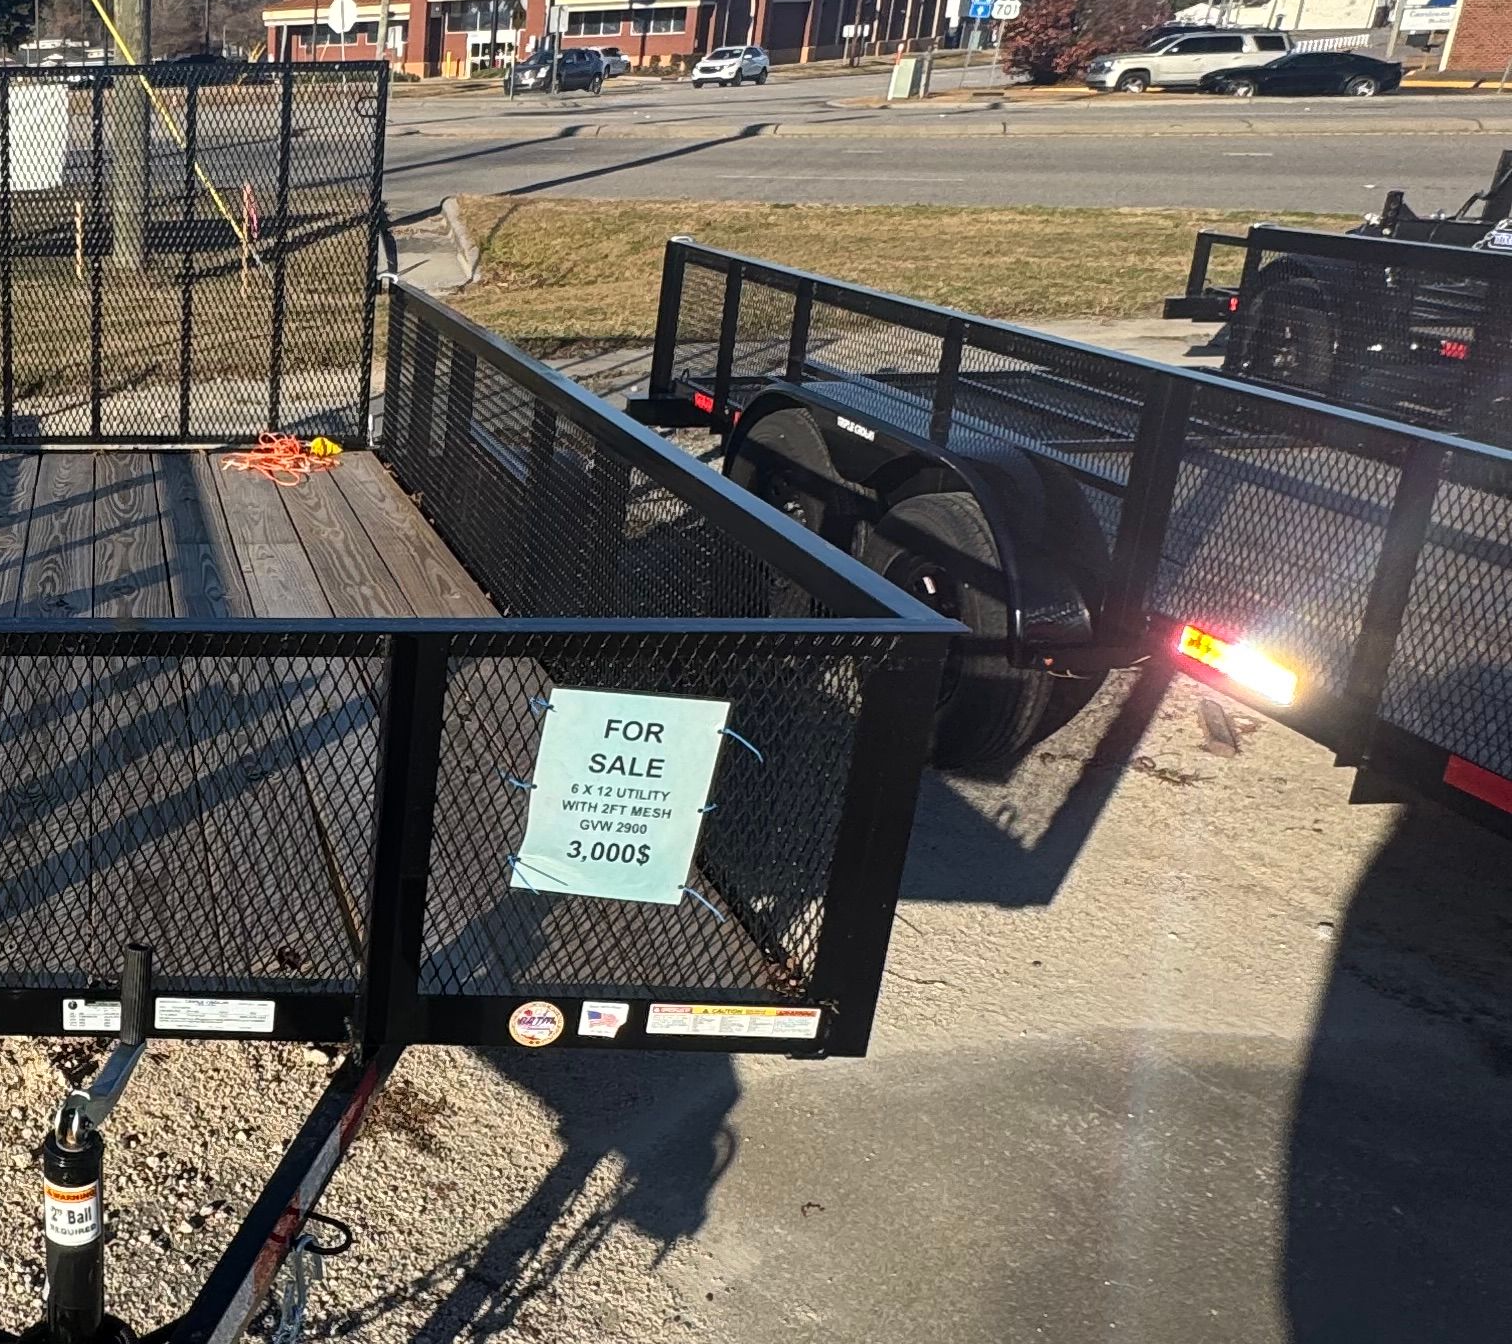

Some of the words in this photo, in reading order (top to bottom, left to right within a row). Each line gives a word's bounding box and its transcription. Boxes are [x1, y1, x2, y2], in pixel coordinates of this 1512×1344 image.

[996, 4, 1018, 16] 701
[604, 719, 664, 743] FOR
[588, 753, 665, 778] SALE
[571, 783, 579, 794] 6
[581, 785, 592, 795] X
[597, 786, 612, 797] 12
[616, 788, 671, 802] UTILITY
[562, 800, 598, 813] WITH
[601, 803, 628, 815] 2FT
[630, 806, 672, 819] MESH
[579, 819, 613, 833] GVW
[615, 821, 648, 834] 2900
[566, 840, 651, 866] 3,000$
[53, 1188, 97, 1201] WARNING
[67, 1206, 92, 1224] Ball
[50, 1223, 97, 1235] REQUIRED
